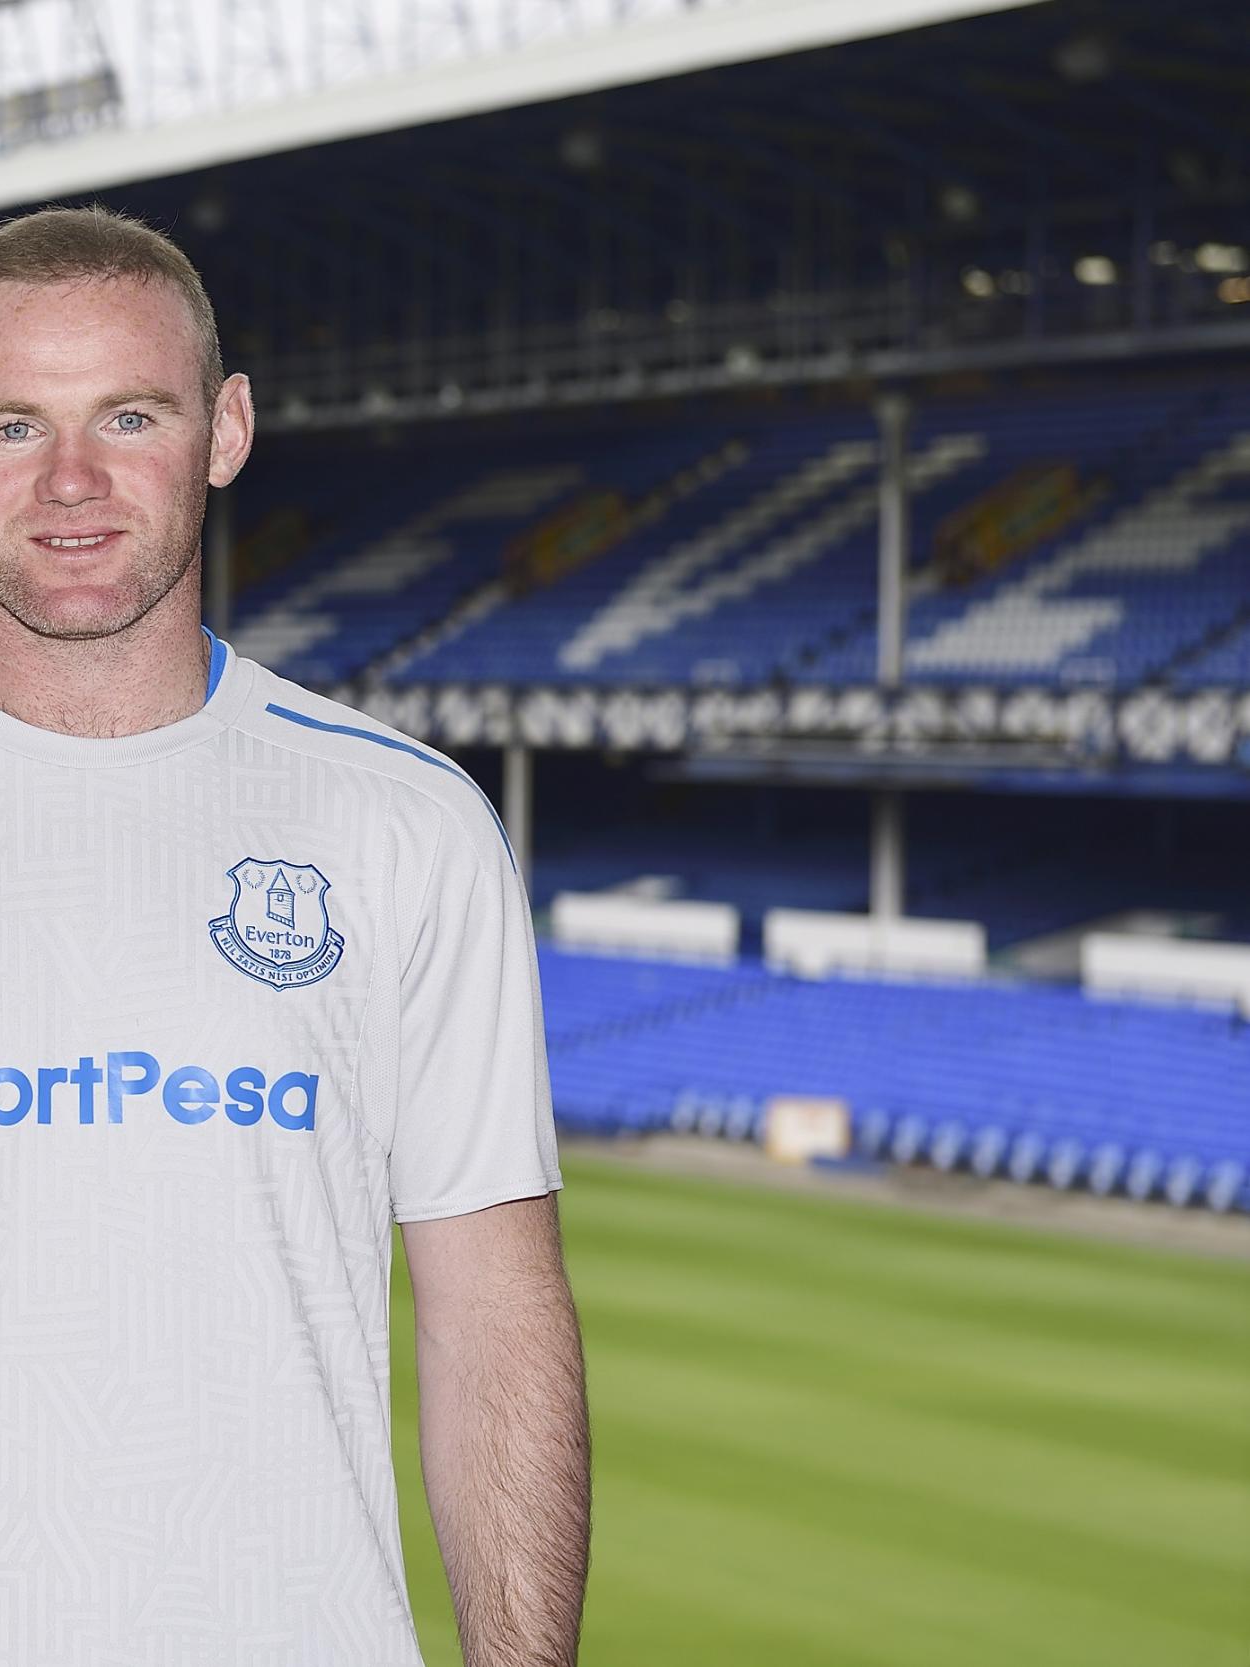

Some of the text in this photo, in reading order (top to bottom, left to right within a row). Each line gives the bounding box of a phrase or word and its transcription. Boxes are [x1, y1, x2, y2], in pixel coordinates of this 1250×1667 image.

[245, 925, 315, 949] Everton
[220, 937, 337, 982] NIL SATIS NISI OPTIMUM
[269, 948, 292, 960] 1878
